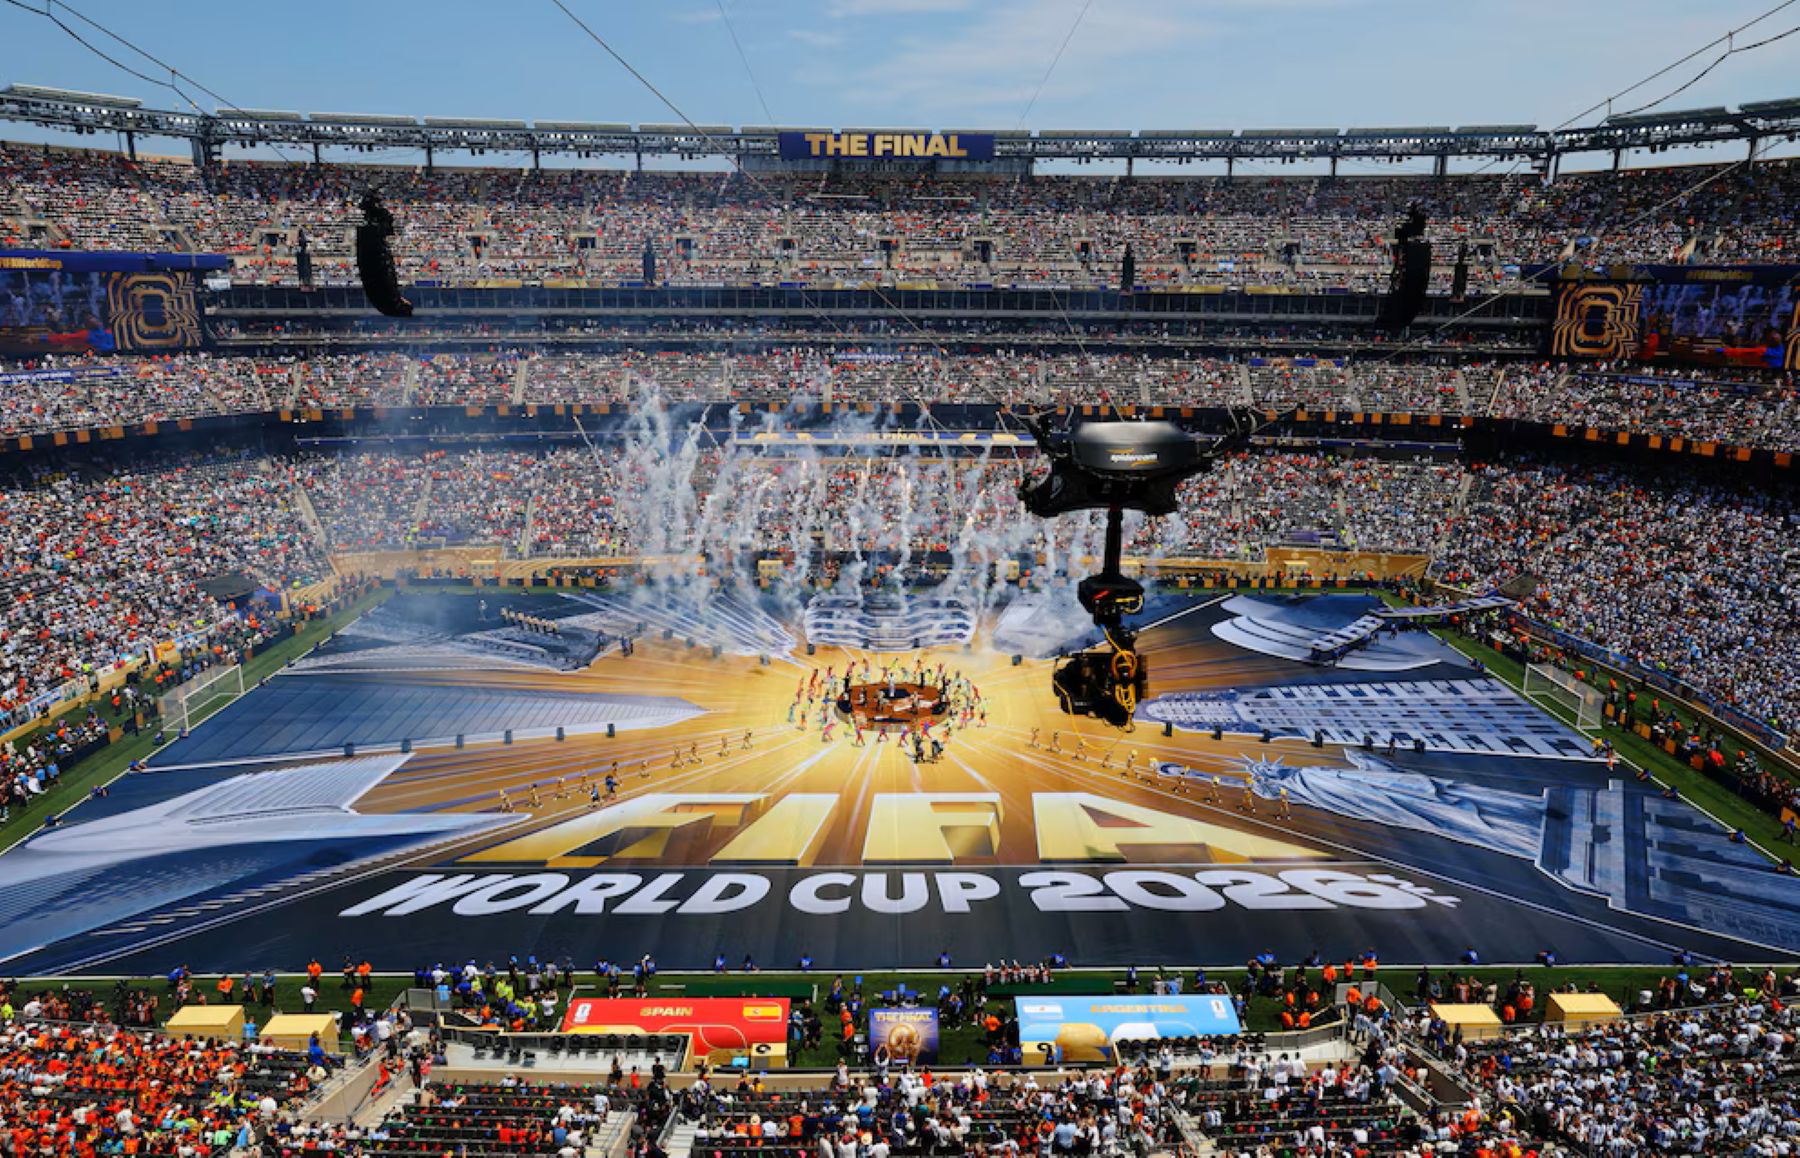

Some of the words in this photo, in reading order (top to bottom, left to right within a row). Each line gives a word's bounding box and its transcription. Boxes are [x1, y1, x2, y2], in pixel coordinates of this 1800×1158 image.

[805, 134, 868, 156] THE
[874, 134, 967, 156] FINAL
[453, 793, 1334, 864] FIFA
[337, 873, 771, 917] WORLD
[789, 872, 1001, 915] CUP
[640, 1006, 693, 1017] SPAIN
[1089, 1004, 1188, 1014] ARGENTINA
